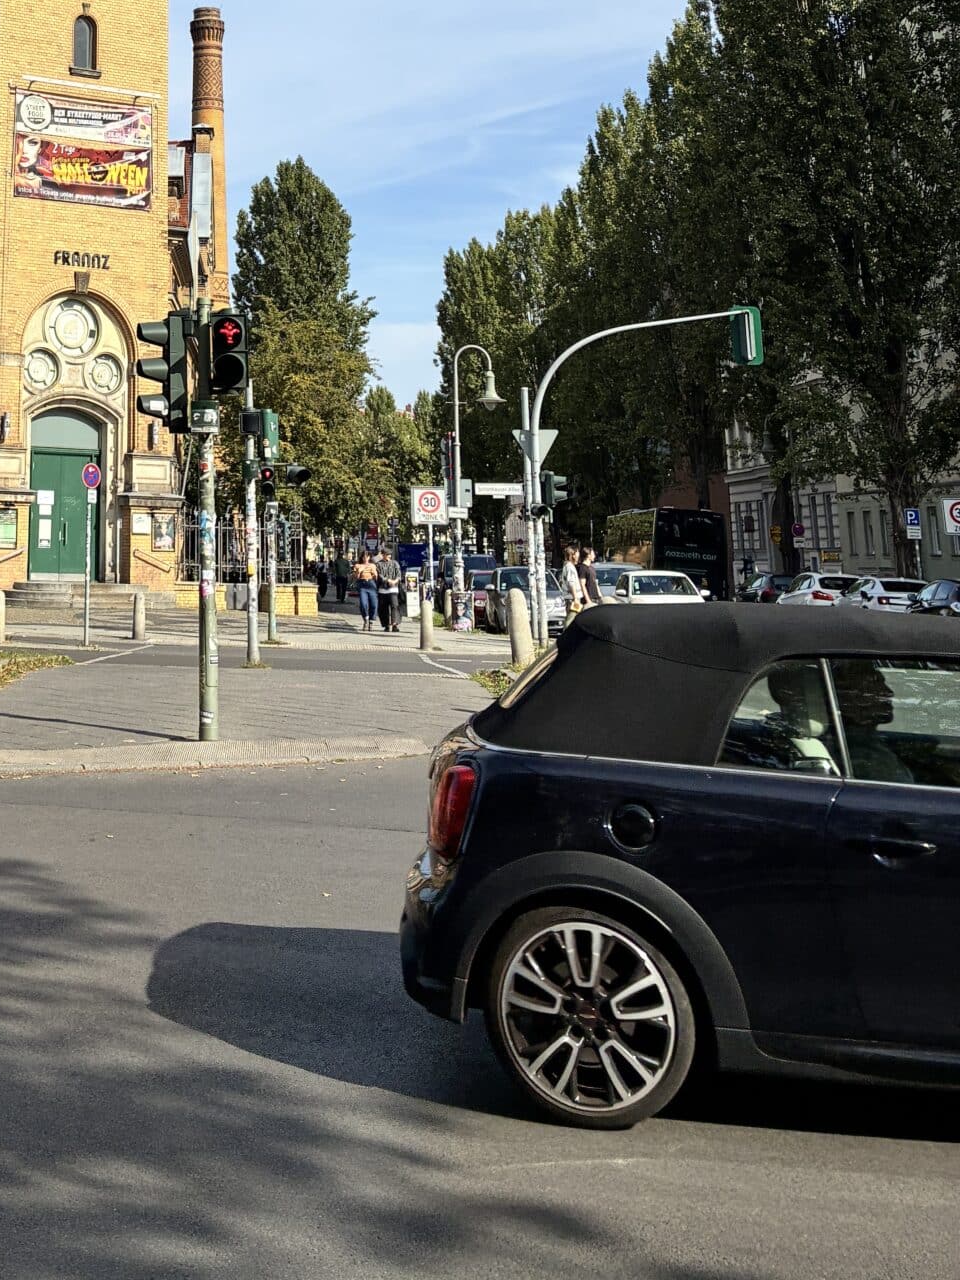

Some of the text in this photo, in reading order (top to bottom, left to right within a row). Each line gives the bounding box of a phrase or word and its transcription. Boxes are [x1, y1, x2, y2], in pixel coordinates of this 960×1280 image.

[52, 142, 76, 155] 2 Tage
[51, 162, 148, 187] HALLOWEEN
[54, 250, 110, 270] FRANNZ
[423, 496, 436, 508] 30
[906, 511, 916, 524] P
